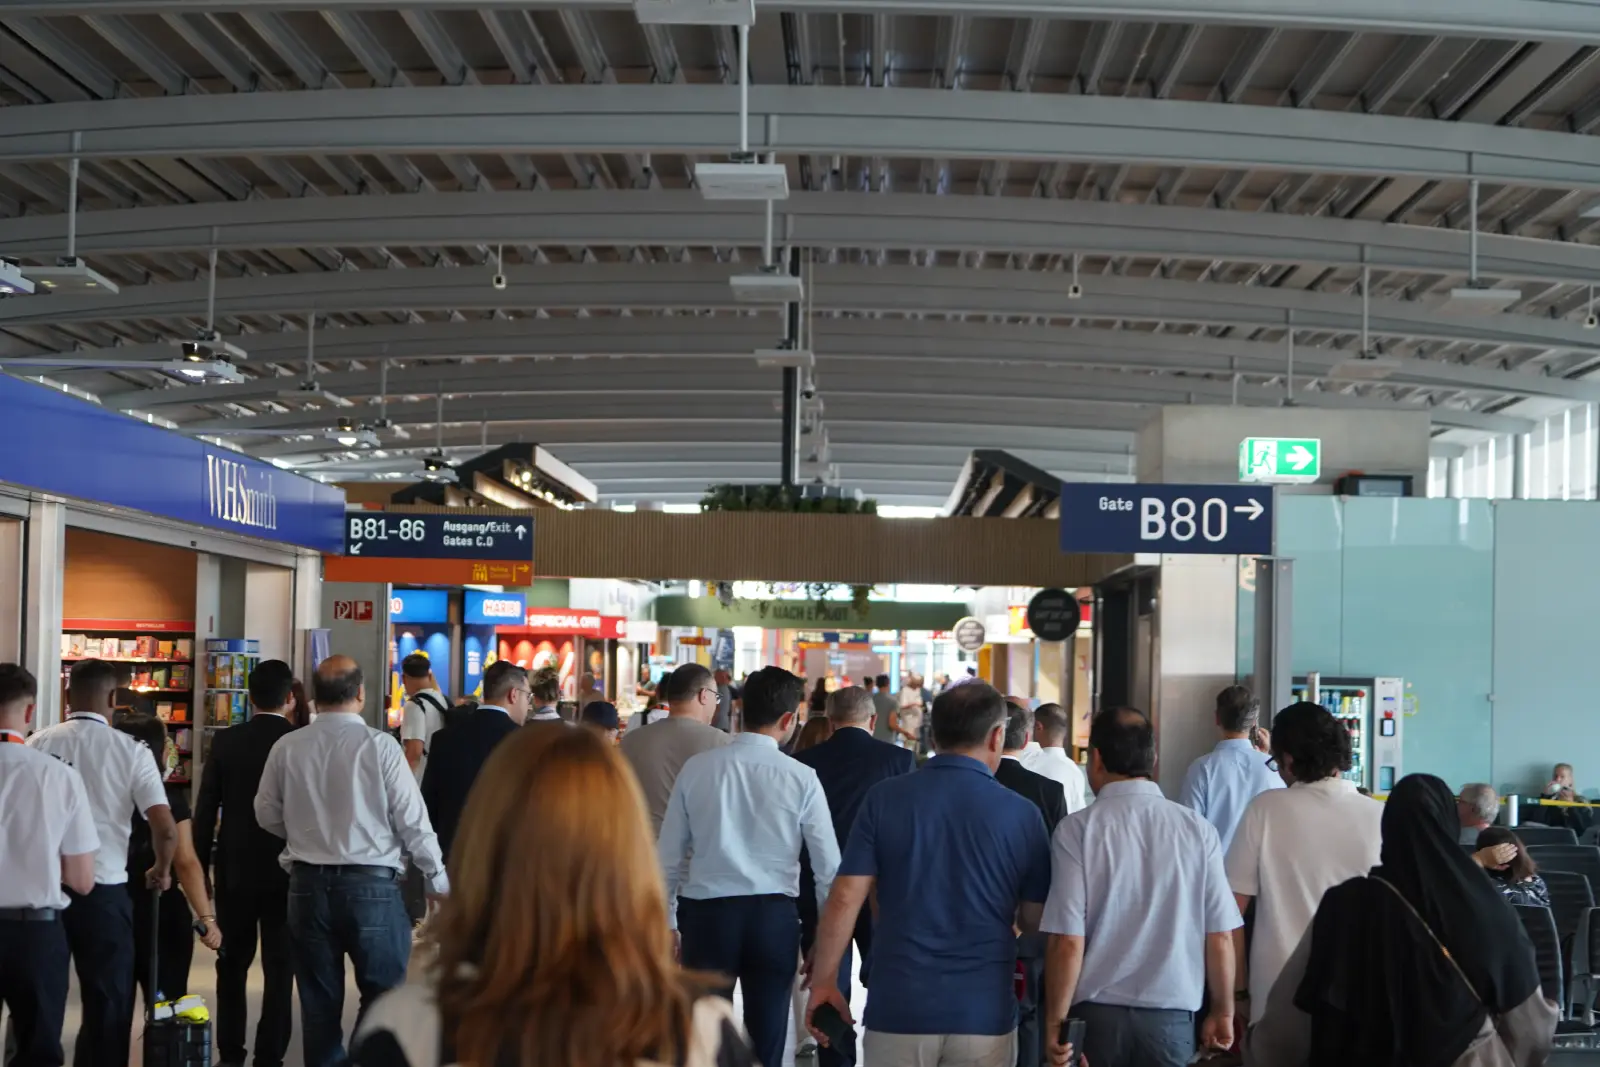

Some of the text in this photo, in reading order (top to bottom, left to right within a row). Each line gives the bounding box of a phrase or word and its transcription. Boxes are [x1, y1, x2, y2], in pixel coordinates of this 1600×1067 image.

[206, 454, 277, 530] WHSmith
[350, 518, 425, 541] B81-86
[443, 521, 511, 534] Ausgang/Exit
[1099, 496, 1228, 541] Gate B80
[443, 535, 473, 546] Gates
